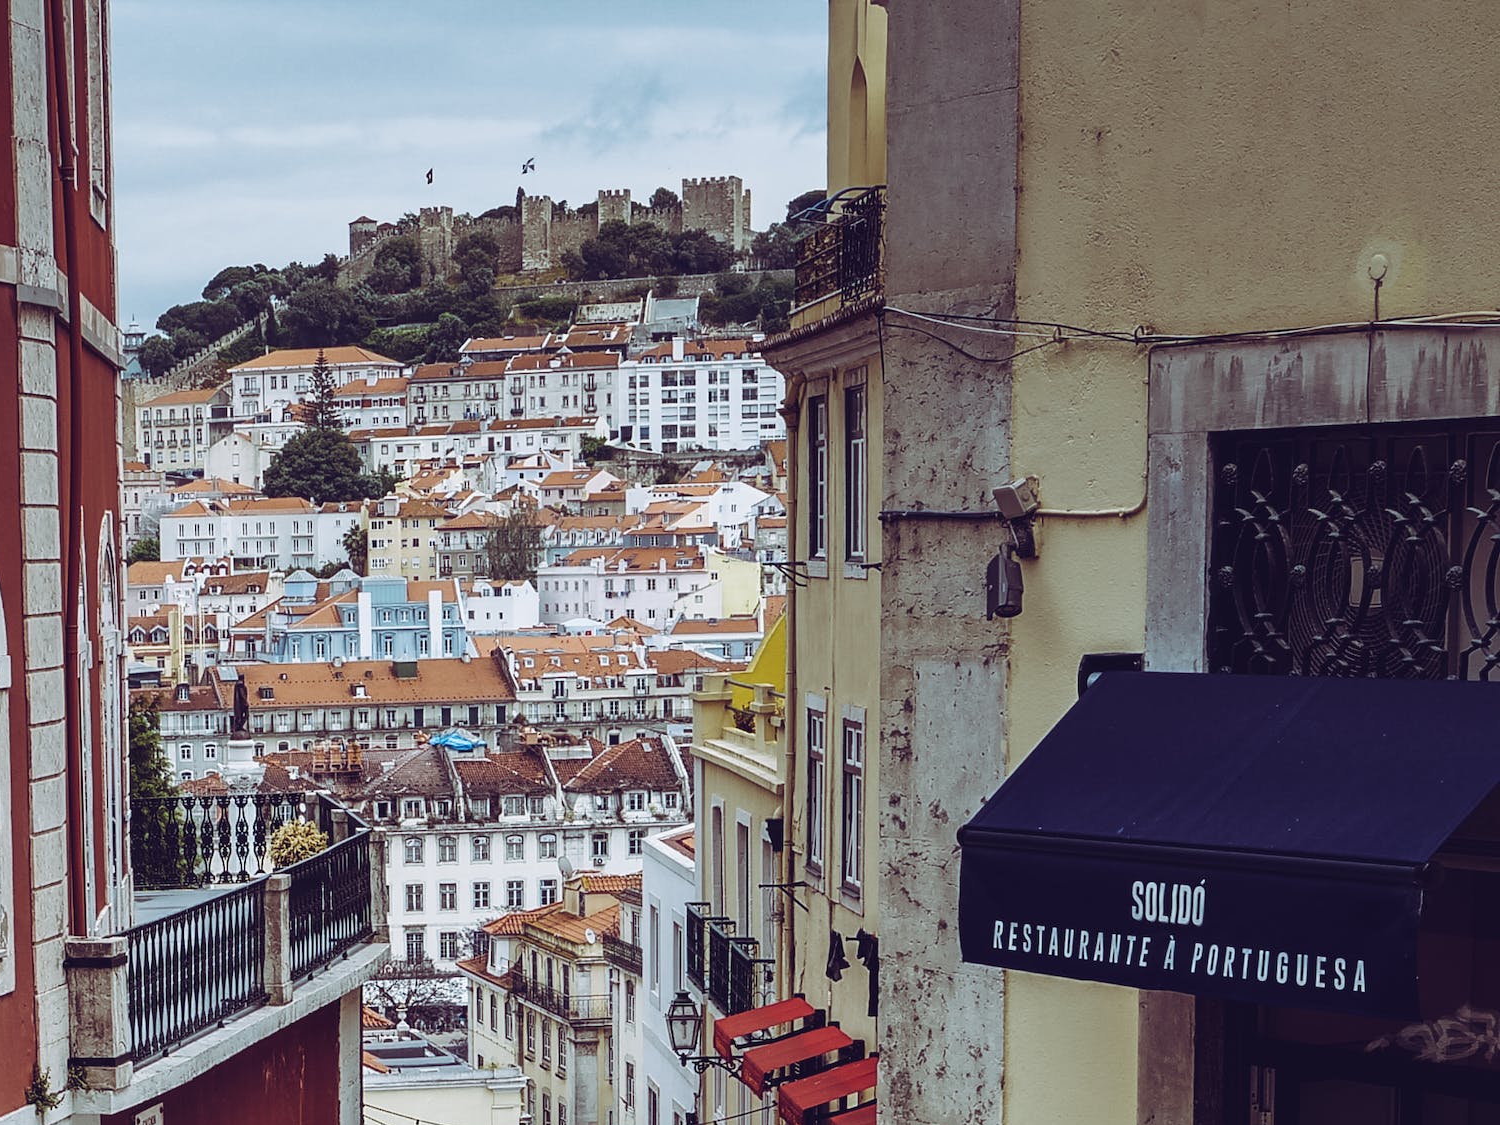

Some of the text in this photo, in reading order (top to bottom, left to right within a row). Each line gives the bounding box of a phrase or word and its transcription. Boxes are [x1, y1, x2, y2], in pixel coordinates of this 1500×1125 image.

[1131, 878, 1206, 926] SOLIDÓ
[993, 920, 1366, 993] RESTAURANTE À PORTUGUESA
